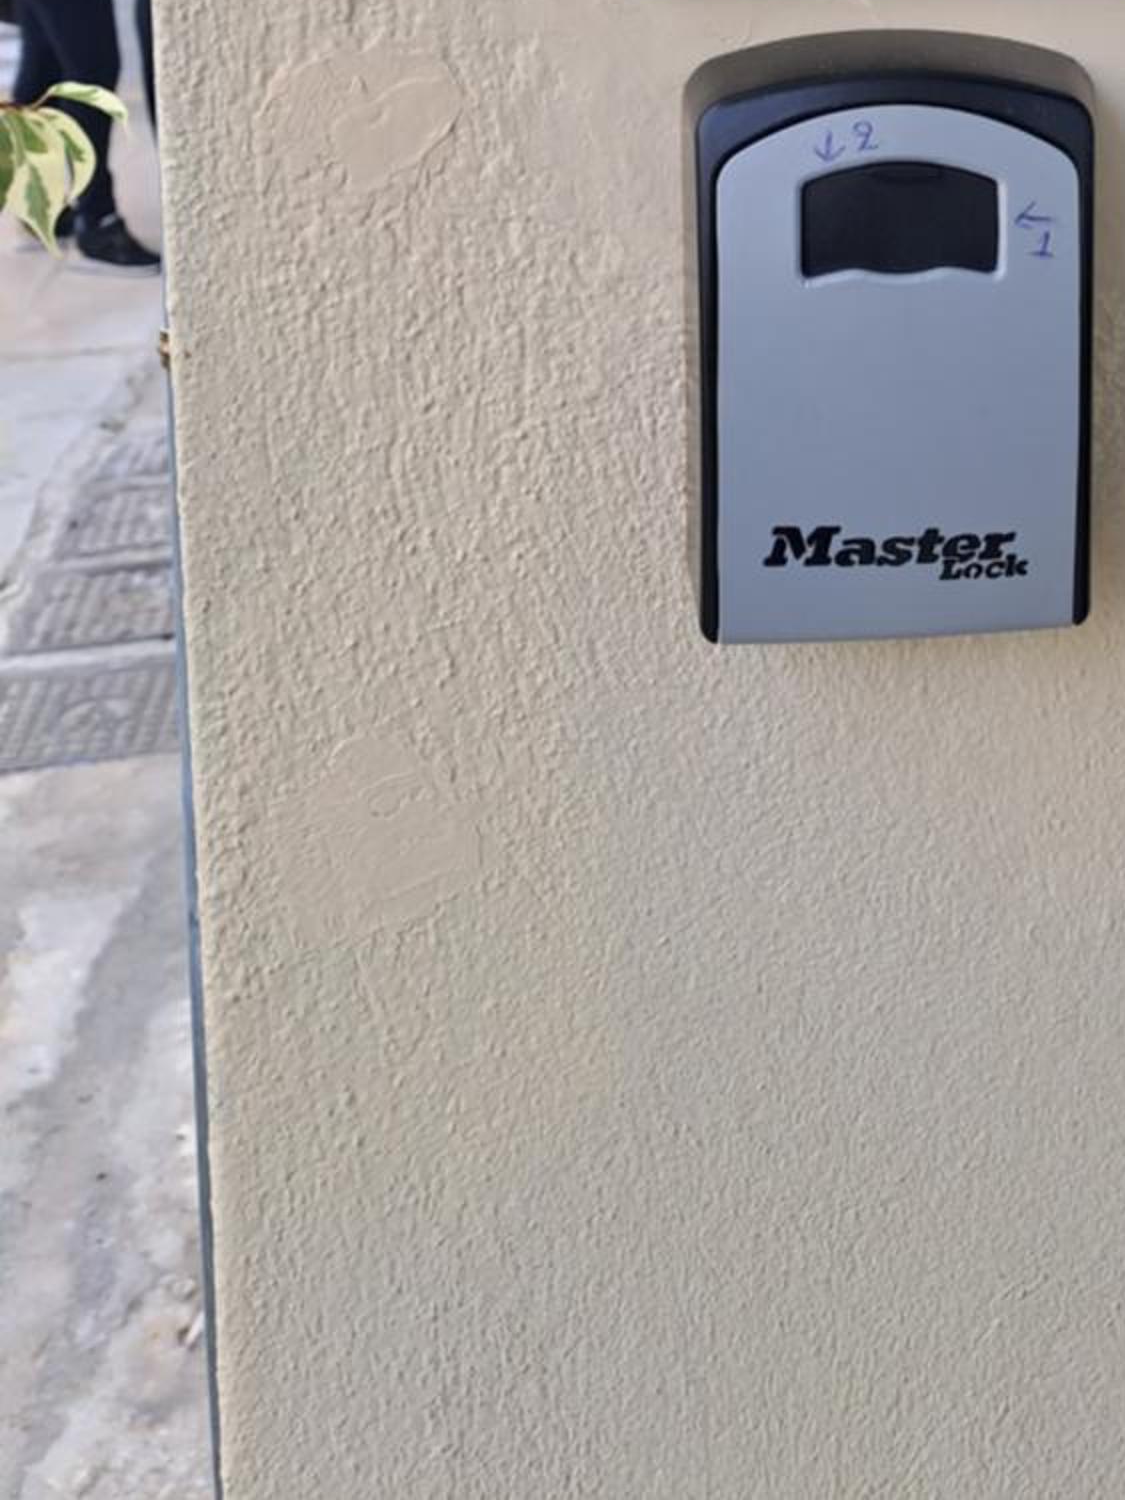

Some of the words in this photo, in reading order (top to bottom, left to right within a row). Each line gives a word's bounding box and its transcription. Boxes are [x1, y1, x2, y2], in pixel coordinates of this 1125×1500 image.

[852, 120, 880, 152] 2
[1030, 230, 1055, 259] 1
[762, 525, 1018, 568] Master
[938, 553, 1030, 581] Lock
